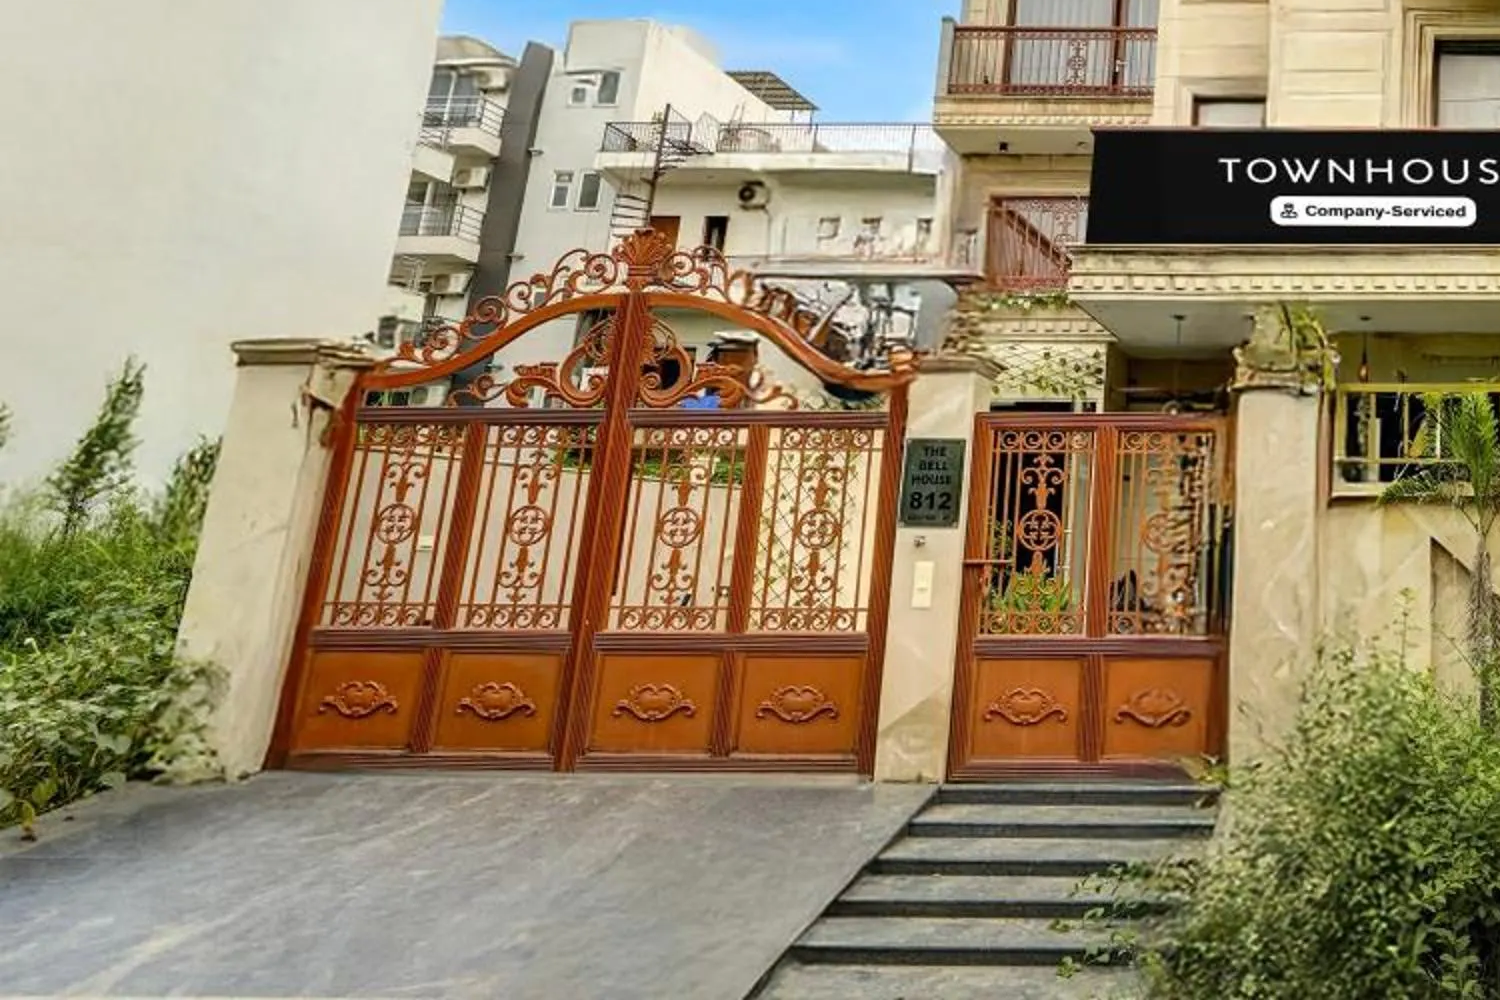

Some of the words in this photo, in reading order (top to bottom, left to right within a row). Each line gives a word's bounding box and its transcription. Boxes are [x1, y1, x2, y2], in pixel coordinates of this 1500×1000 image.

[1304, 203, 1467, 221] Company-Serviced
[923, 446, 947, 457] THE
[909, 491, 952, 510] 812
